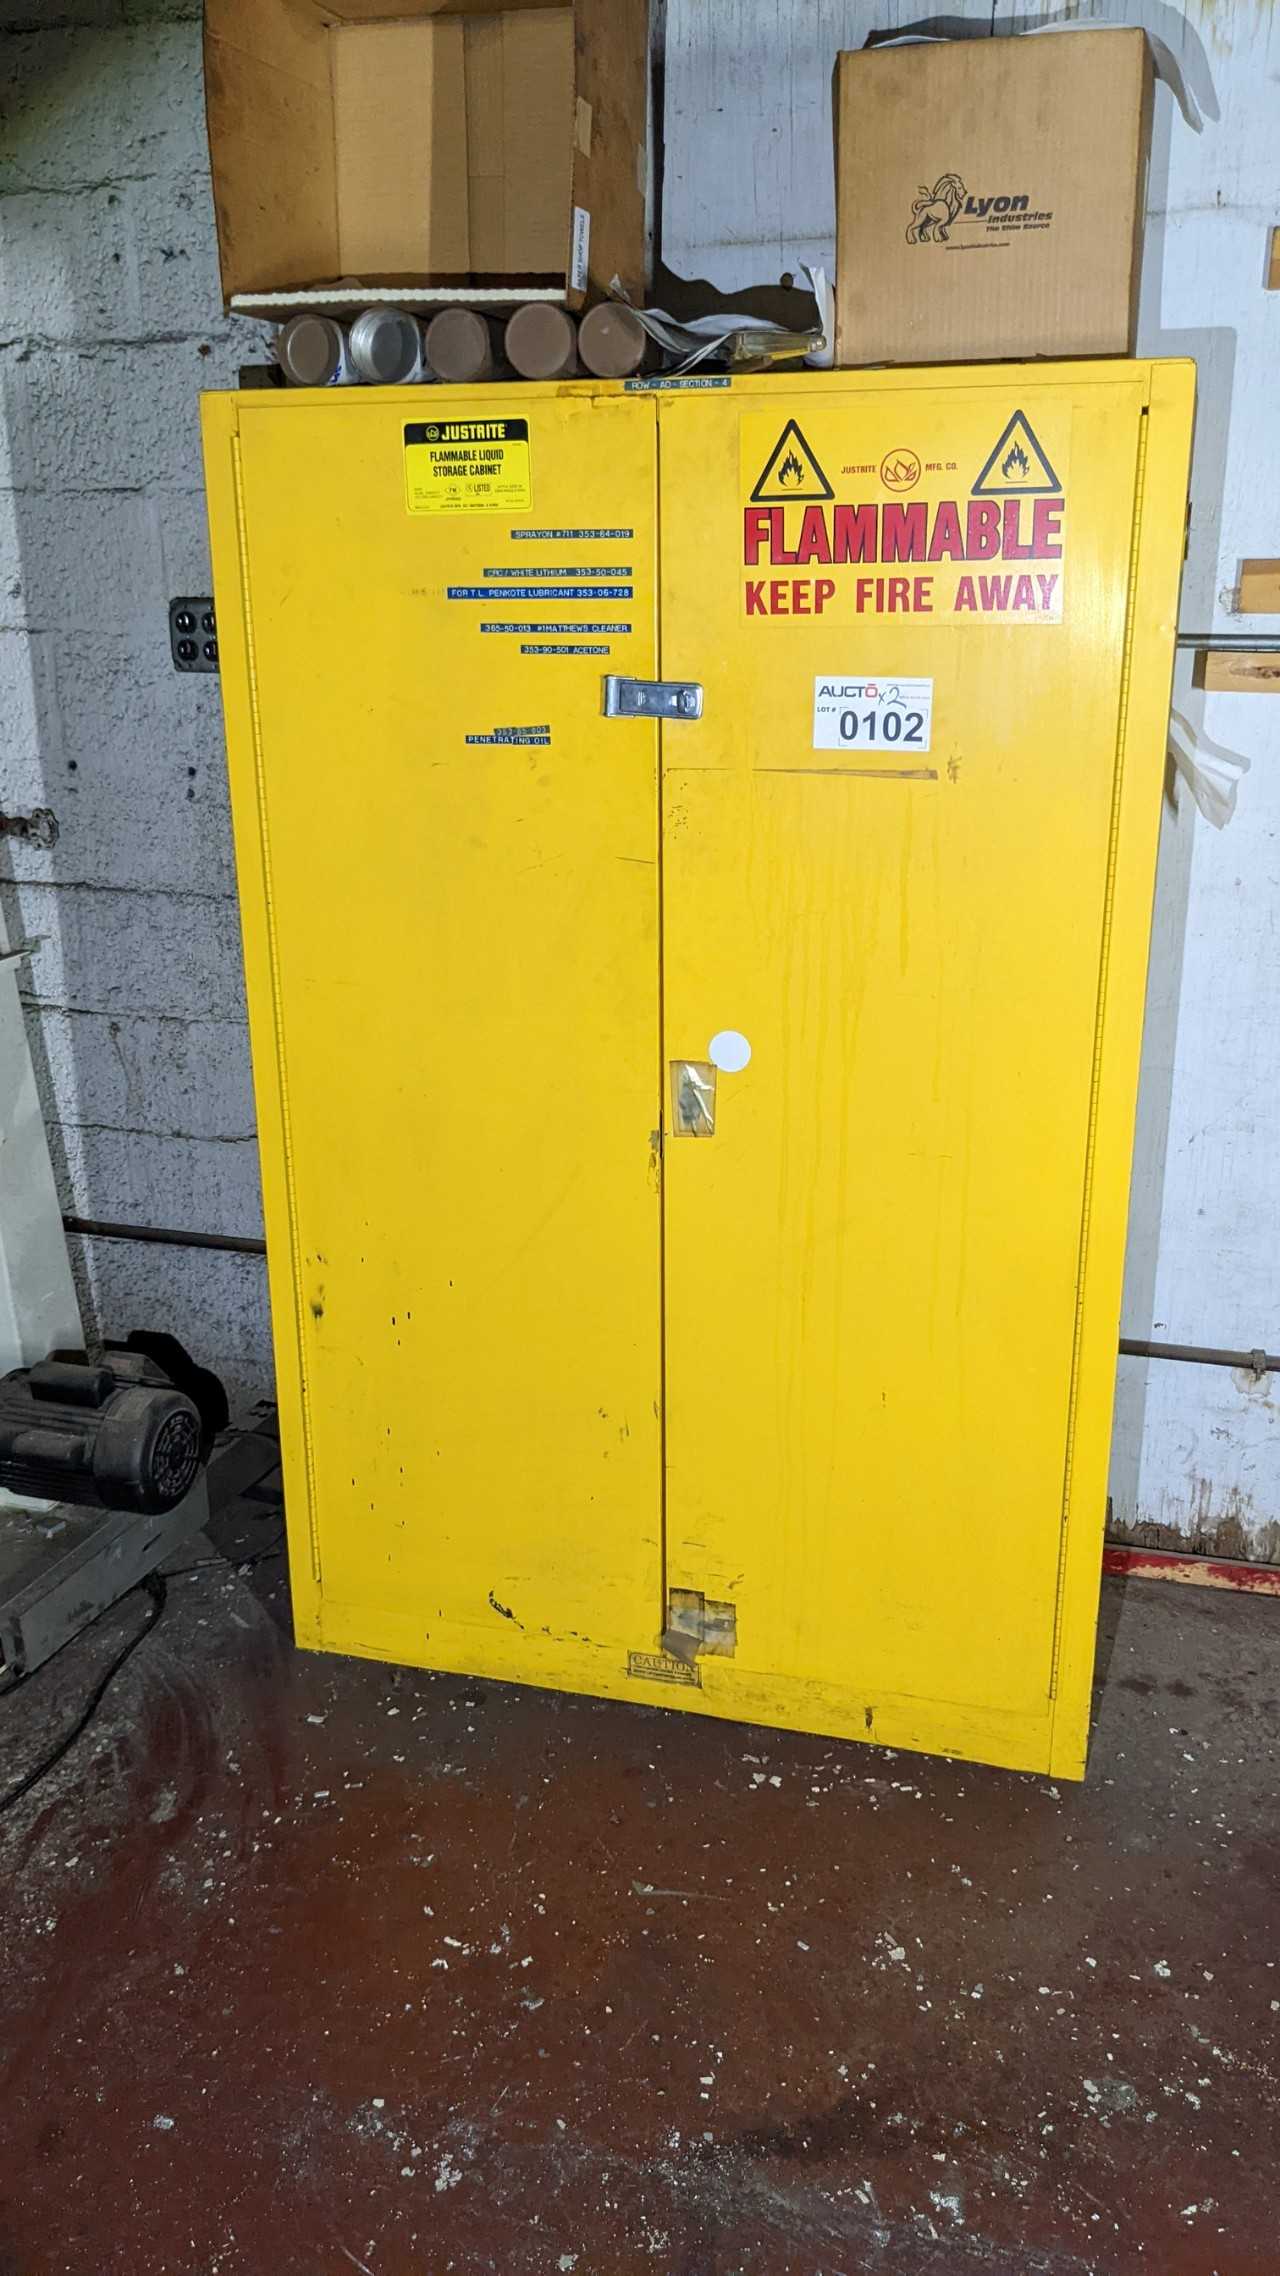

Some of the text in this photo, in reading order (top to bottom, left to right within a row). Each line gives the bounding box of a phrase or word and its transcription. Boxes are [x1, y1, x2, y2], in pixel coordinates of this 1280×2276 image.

[964, 195, 1030, 217] Lyon
[631, 382, 650, 390] ROW
[680, 378, 712, 388] SECTION
[722, 379, 730, 387] 4
[441, 424, 506, 440] JUSTRITE
[430, 449, 504, 463] FLAMMABLE LIQUID
[433, 464, 502, 477] STORAGE CABINET
[841, 464, 877, 474] JUSTRITE
[925, 462, 958, 472] MFG. CO.
[515, 530, 552, 538] SPRAYON
[744, 498, 1065, 566] FLAMMABLE
[451, 589, 468, 597] FOR
[488, 589, 526, 597] PENKOTE
[528, 589, 574, 597] LUBRICANT
[745, 574, 1059, 616] KEEP FIRE AWAY
[591, 624, 628, 632] CLEANER
[573, 646, 608, 654] ACETONE
[839, 710, 924, 742] 0102
[468, 736, 530, 744] PENETRATING
